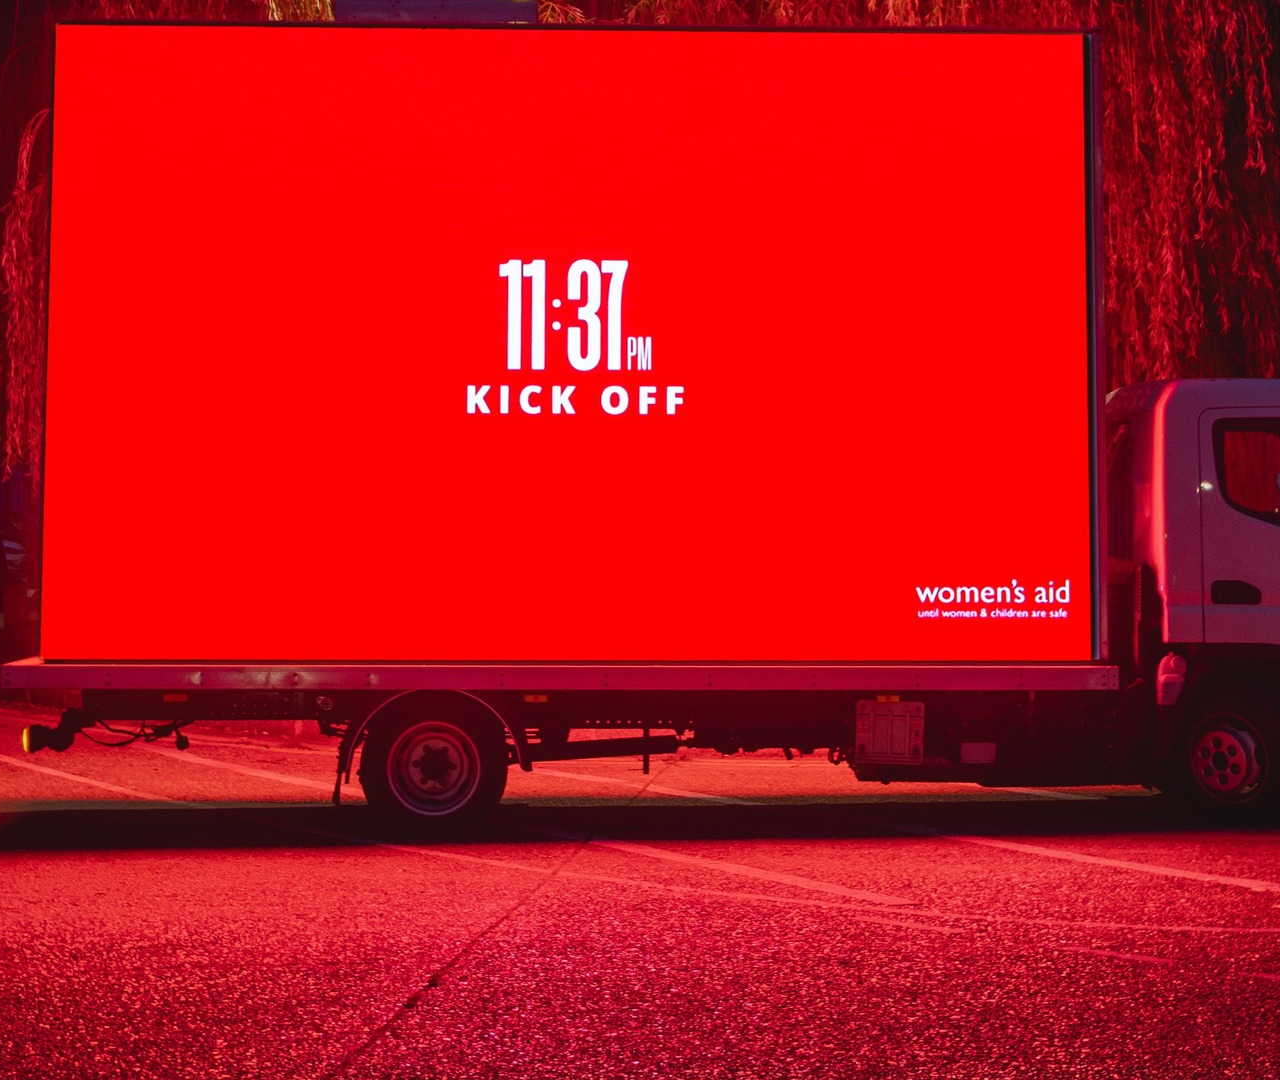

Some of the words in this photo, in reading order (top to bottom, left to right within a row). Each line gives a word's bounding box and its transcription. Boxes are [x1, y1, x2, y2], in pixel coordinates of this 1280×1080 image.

[466, 384, 576, 415] KICK
[600, 385, 685, 415] OFF
[1034, 579, 1070, 604] aid
[917, 608, 939, 618] until
[941, 610, 978, 618] women
[979, 608, 988, 618] &
[990, 608, 1029, 618] children
[1031, 610, 1047, 618] are
[1049, 608, 1068, 618] safe
